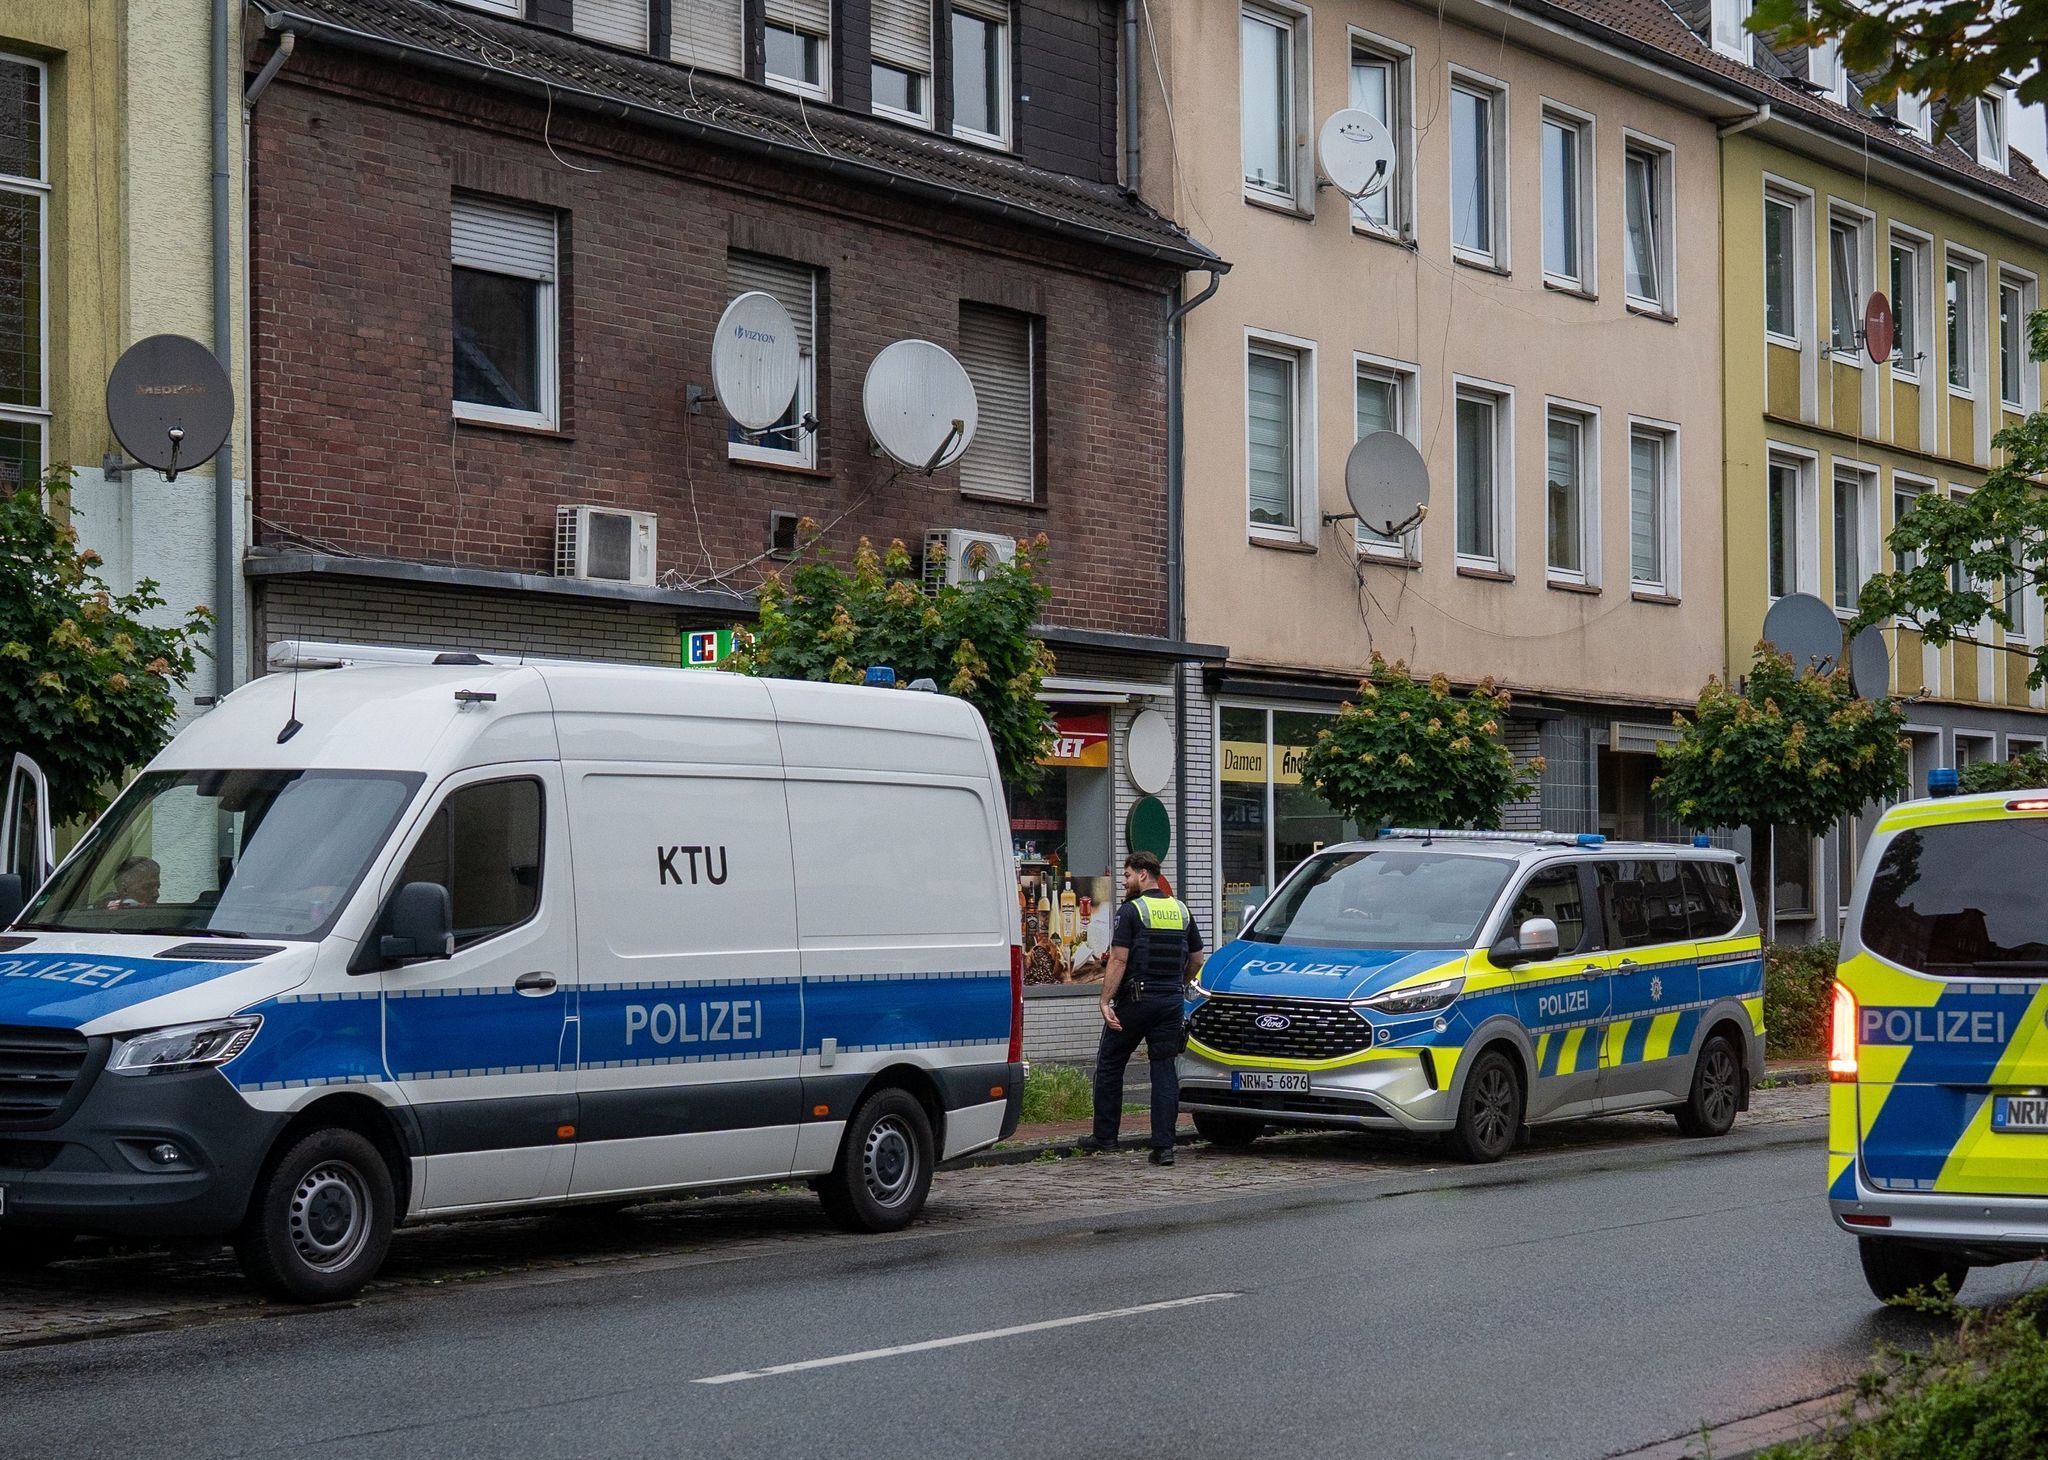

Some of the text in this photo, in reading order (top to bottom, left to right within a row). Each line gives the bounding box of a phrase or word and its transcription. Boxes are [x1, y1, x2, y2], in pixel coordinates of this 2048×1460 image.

[744, 329, 776, 344] VIZYON
[1053, 738, 1084, 758] KET
[1224, 748, 1262, 771] Damen
[1282, 745, 1306, 776] Änd
[657, 846, 728, 885] KTU
[1151, 909, 1181, 921] POLIZEI
[1241, 959, 1360, 977] POLIZEI
[1538, 989, 1589, 1018] POLIZEI
[625, 1000, 762, 1046] POLIZEI
[1260, 1016, 1284, 1028] Ford
[1862, 1009, 2005, 1043] POLIZEI
[1240, 1074, 1307, 1090] NRW 5-6876
[2007, 1100, 2048, 1125] NRW
